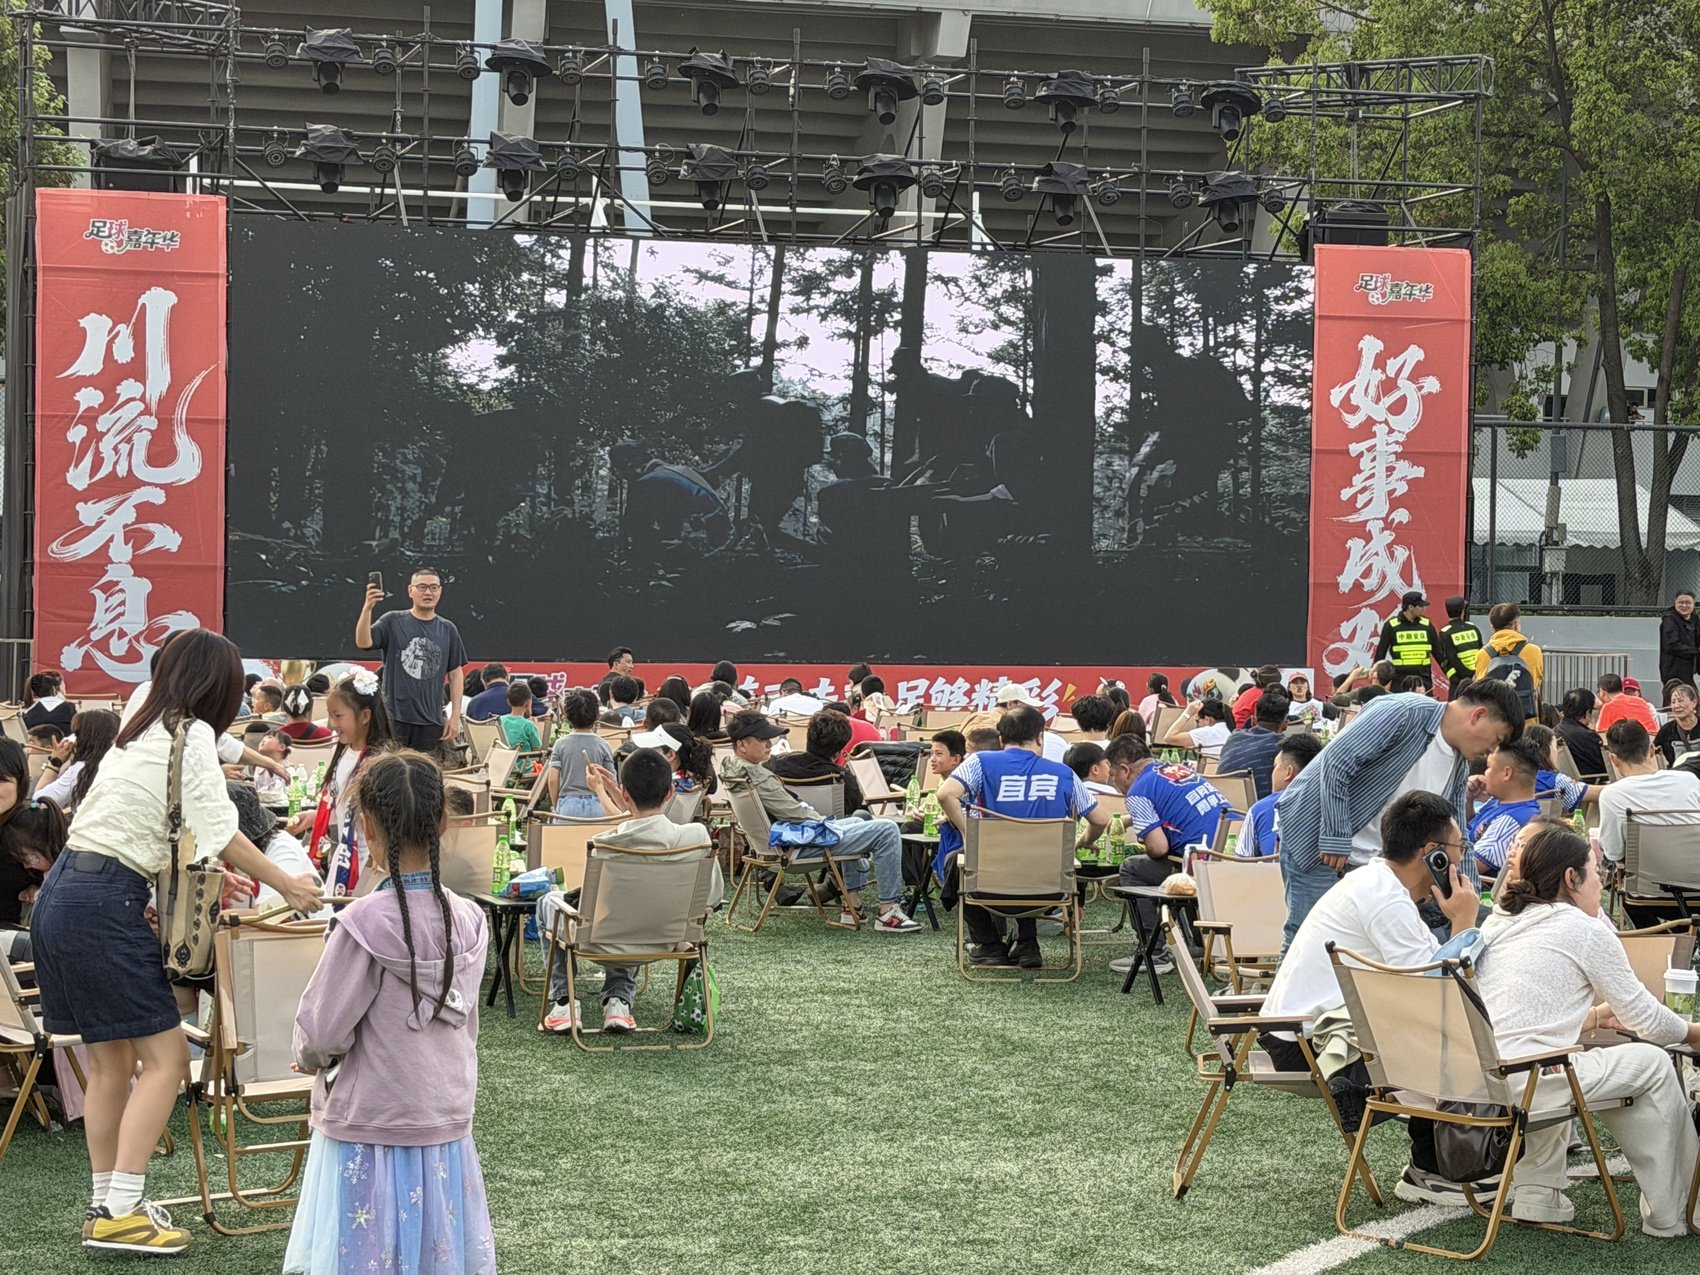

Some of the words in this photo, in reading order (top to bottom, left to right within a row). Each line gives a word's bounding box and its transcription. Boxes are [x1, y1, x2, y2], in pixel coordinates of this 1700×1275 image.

[83, 219, 181, 253] 足球嘉年华
[1354, 273, 1434, 305] 足球嘉年华
[48, 286, 219, 683] 川流不息
[996, 774, 1059, 801] 宜宾
